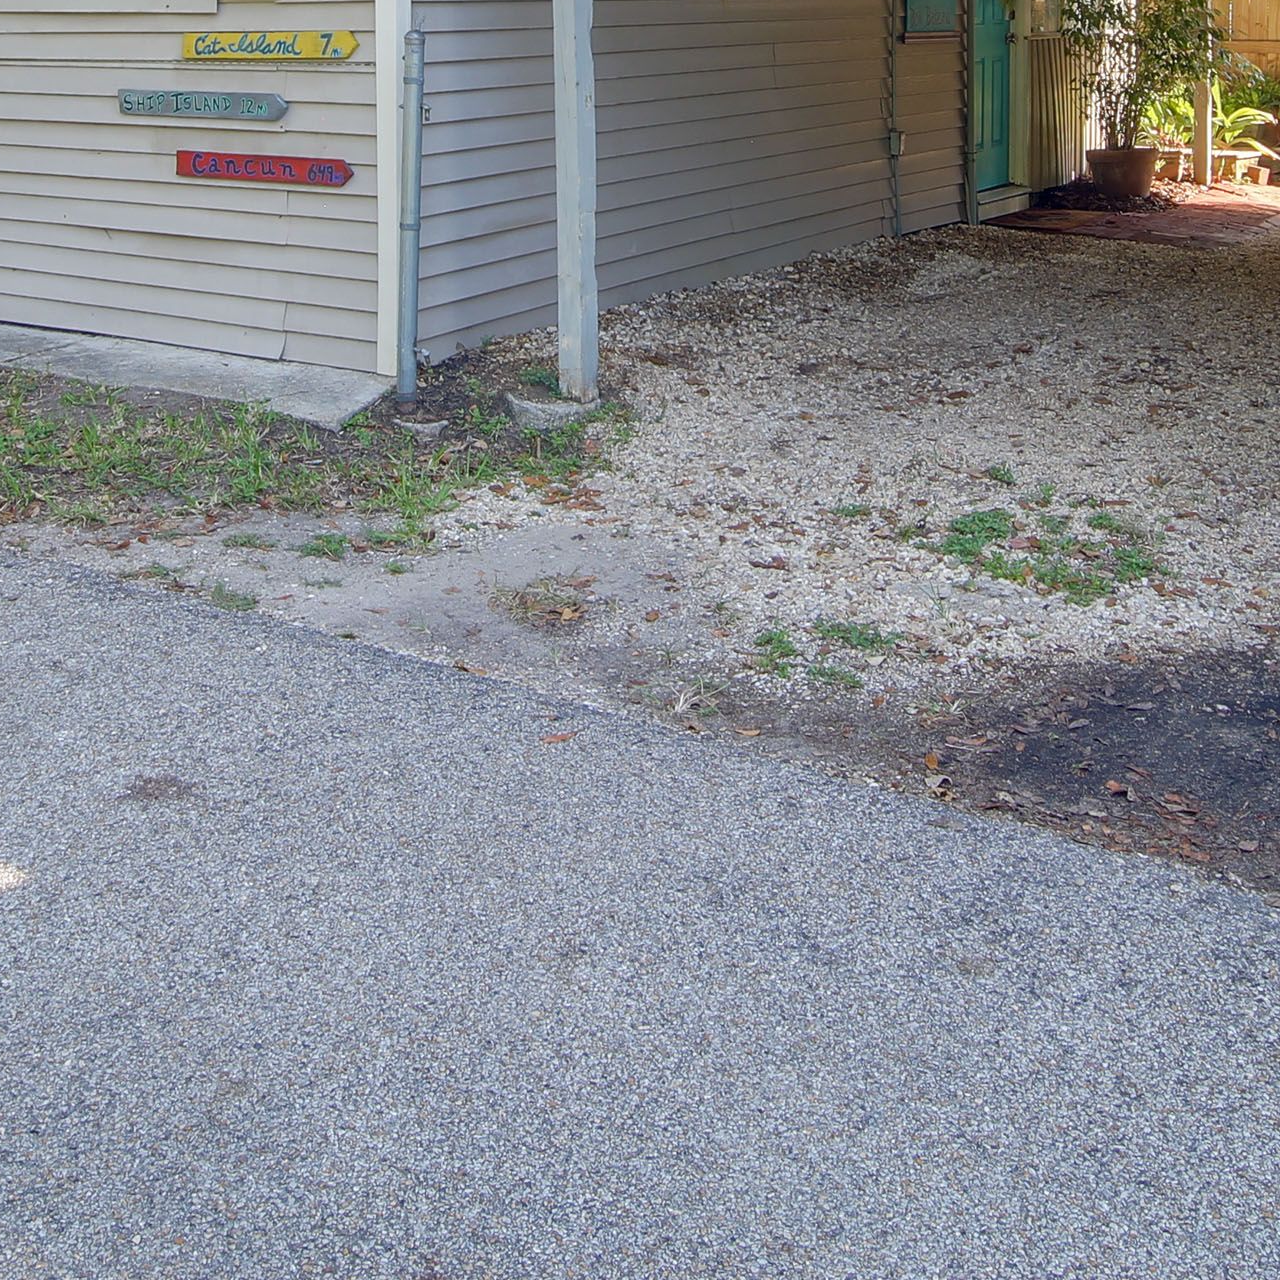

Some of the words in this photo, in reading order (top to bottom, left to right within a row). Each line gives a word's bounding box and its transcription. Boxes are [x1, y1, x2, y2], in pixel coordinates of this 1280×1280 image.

[320, 32, 333, 56] 7
[123, 93, 166, 112] SHIP
[170, 92, 232, 114] ISLAND
[239, 98, 255, 115] 12
[191, 152, 296, 178] Cancun
[307, 163, 334, 183] 649
